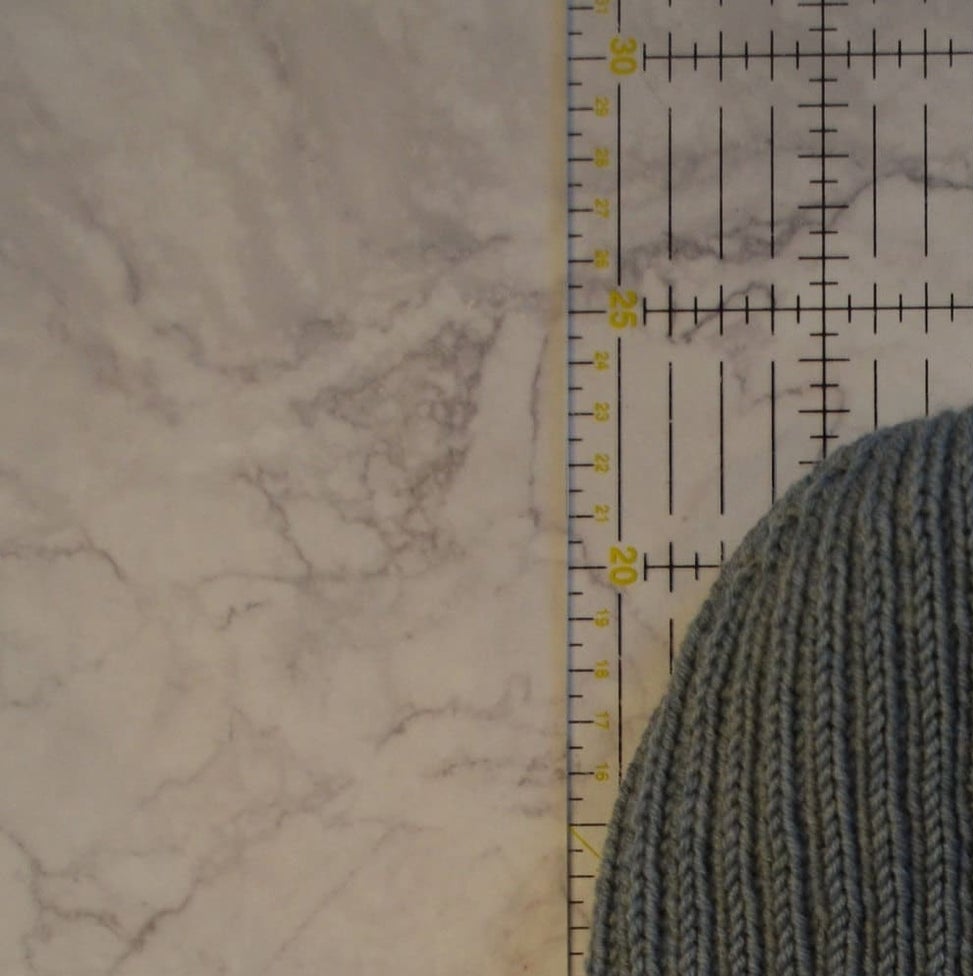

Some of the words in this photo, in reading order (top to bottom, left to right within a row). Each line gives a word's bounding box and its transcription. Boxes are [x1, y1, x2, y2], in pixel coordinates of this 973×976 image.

[608, 37, 638, 76] 30
[595, 97, 609, 117] 29
[595, 148, 610, 168] 28
[595, 199, 609, 219] 27
[608, 289, 638, 330] 25
[594, 351, 609, 371] 24
[594, 402, 609, 422] 23
[594, 453, 609, 474] 22
[594, 504, 609, 524] 21
[608, 546, 638, 587] 20
[594, 608, 609, 629] 19
[594, 660, 609, 680] 18
[594, 711, 610, 731] 17
[594, 762, 609, 782] 16
